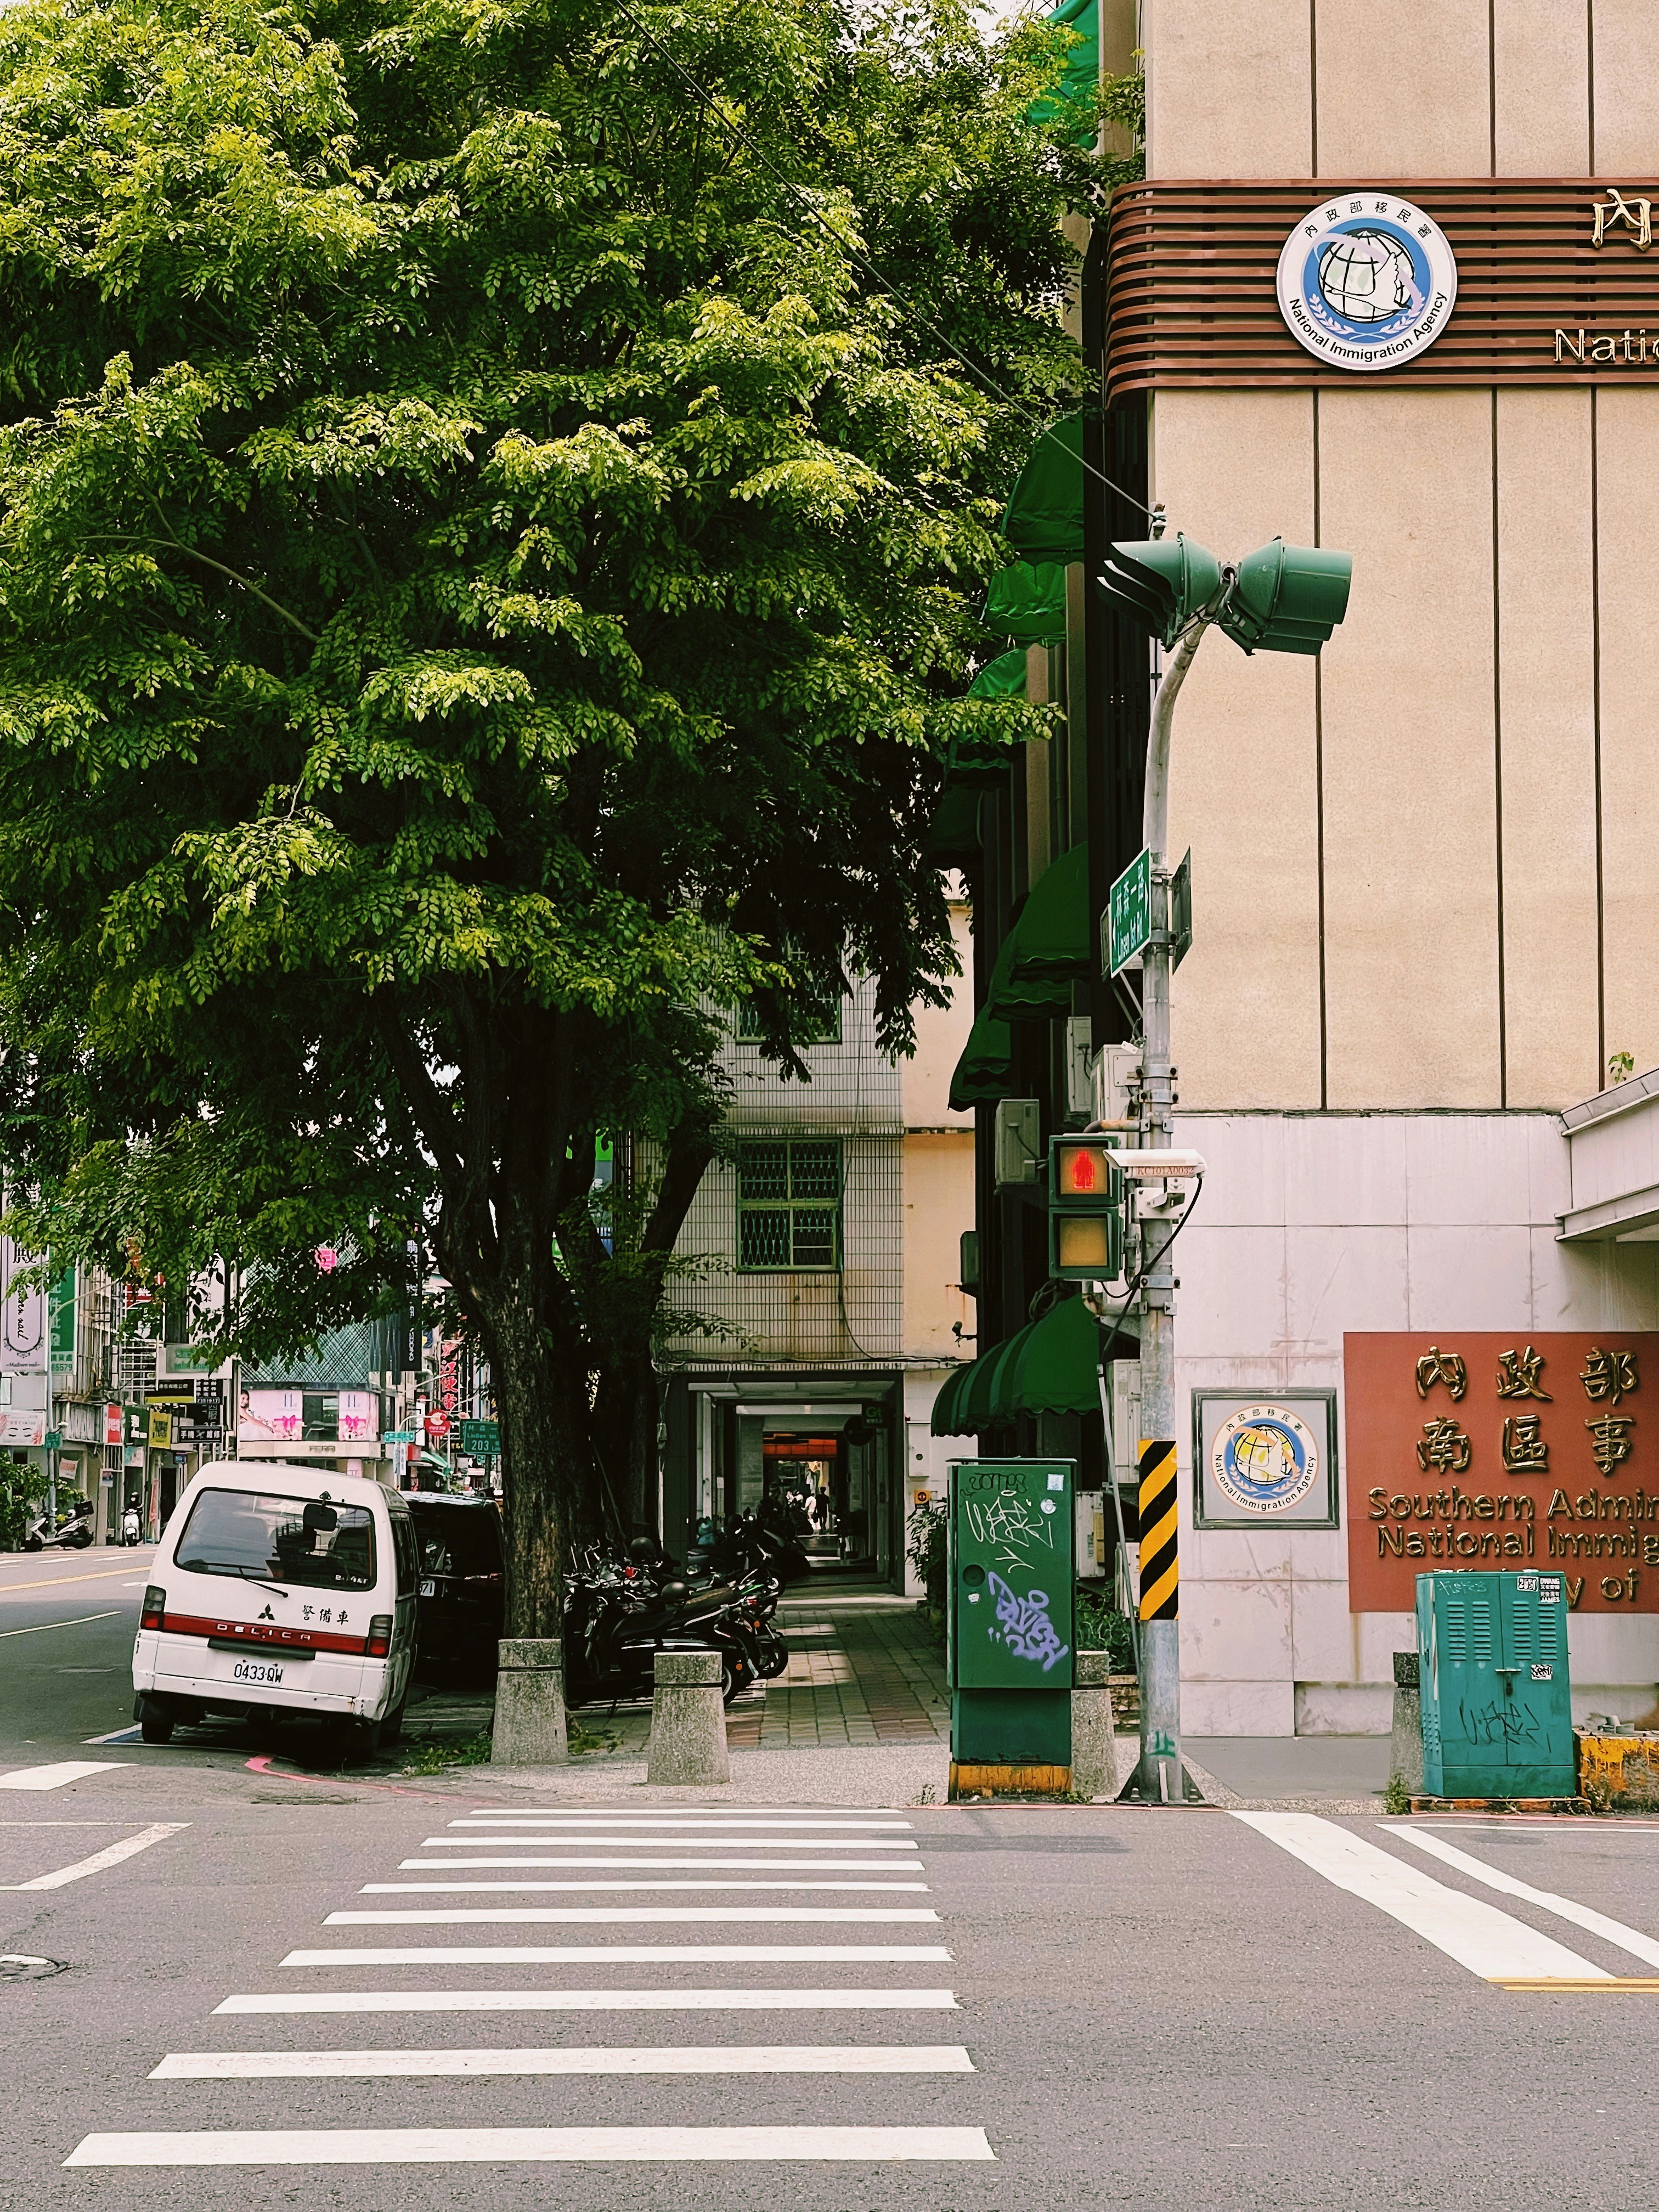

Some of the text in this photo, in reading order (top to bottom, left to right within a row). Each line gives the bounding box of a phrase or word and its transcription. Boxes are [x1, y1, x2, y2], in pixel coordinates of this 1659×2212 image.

[1305, 201, 1432, 238] 內政部移民署
[1289, 292, 1447, 363] National Immigration Agency
[1137, 1166, 1194, 1175] KC101A0032
[1415, 1345, 1639, 1405] 內政部
[472, 1440, 489, 1451] 203
[1417, 1413, 1636, 1476] 南區事
[1215, 1454, 1317, 1511] National Immigration Agency
[1368, 1485, 1536, 1521] Southern
[1378, 1523, 1536, 1558] National
[1600, 1567, 1638, 1601] of
[217, 1623, 311, 1641] DELICA
[302, 1605, 349, 1625] 警備車
